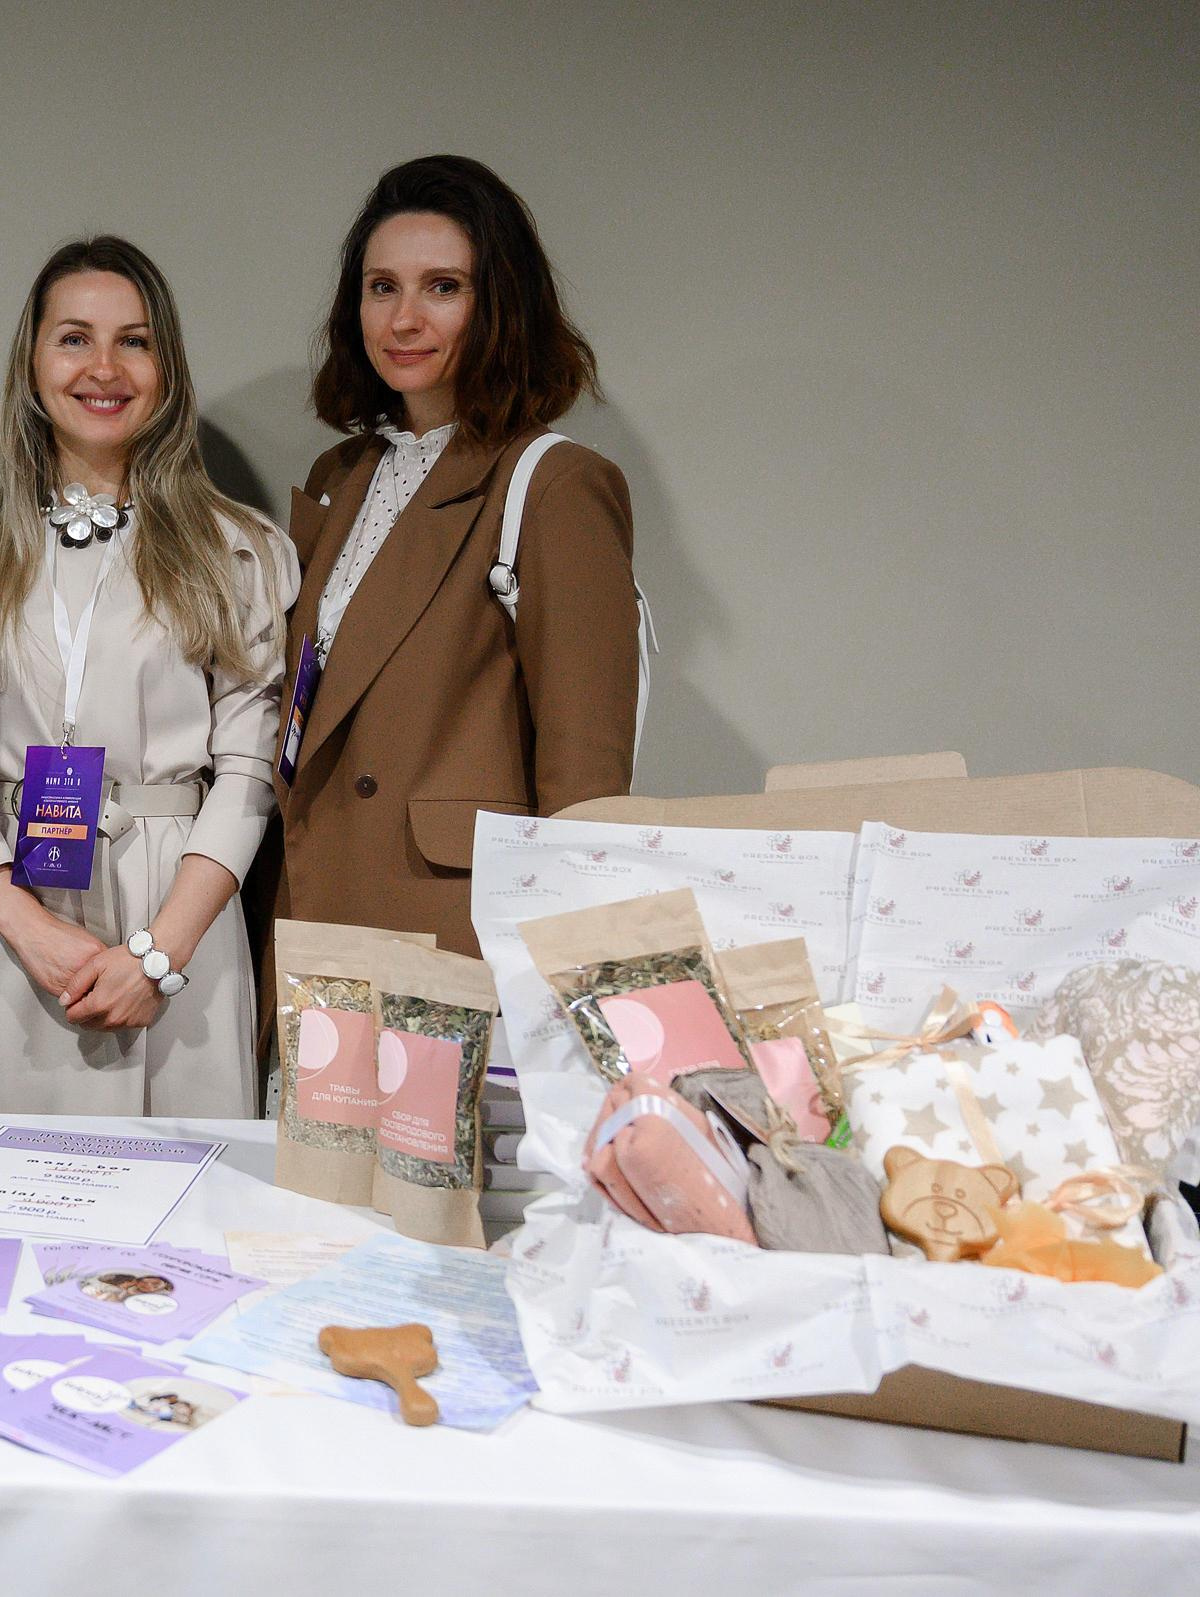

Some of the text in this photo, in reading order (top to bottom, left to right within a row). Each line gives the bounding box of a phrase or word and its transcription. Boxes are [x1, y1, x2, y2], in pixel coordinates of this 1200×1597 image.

[35, 804, 82, 819] НАВИТА
[329, 1083, 360, 1095] ТРАВЫ
[311, 1091, 378, 1107] ДЛЯ КУПАНИЯ
[391, 1110, 412, 1121] СБОР
